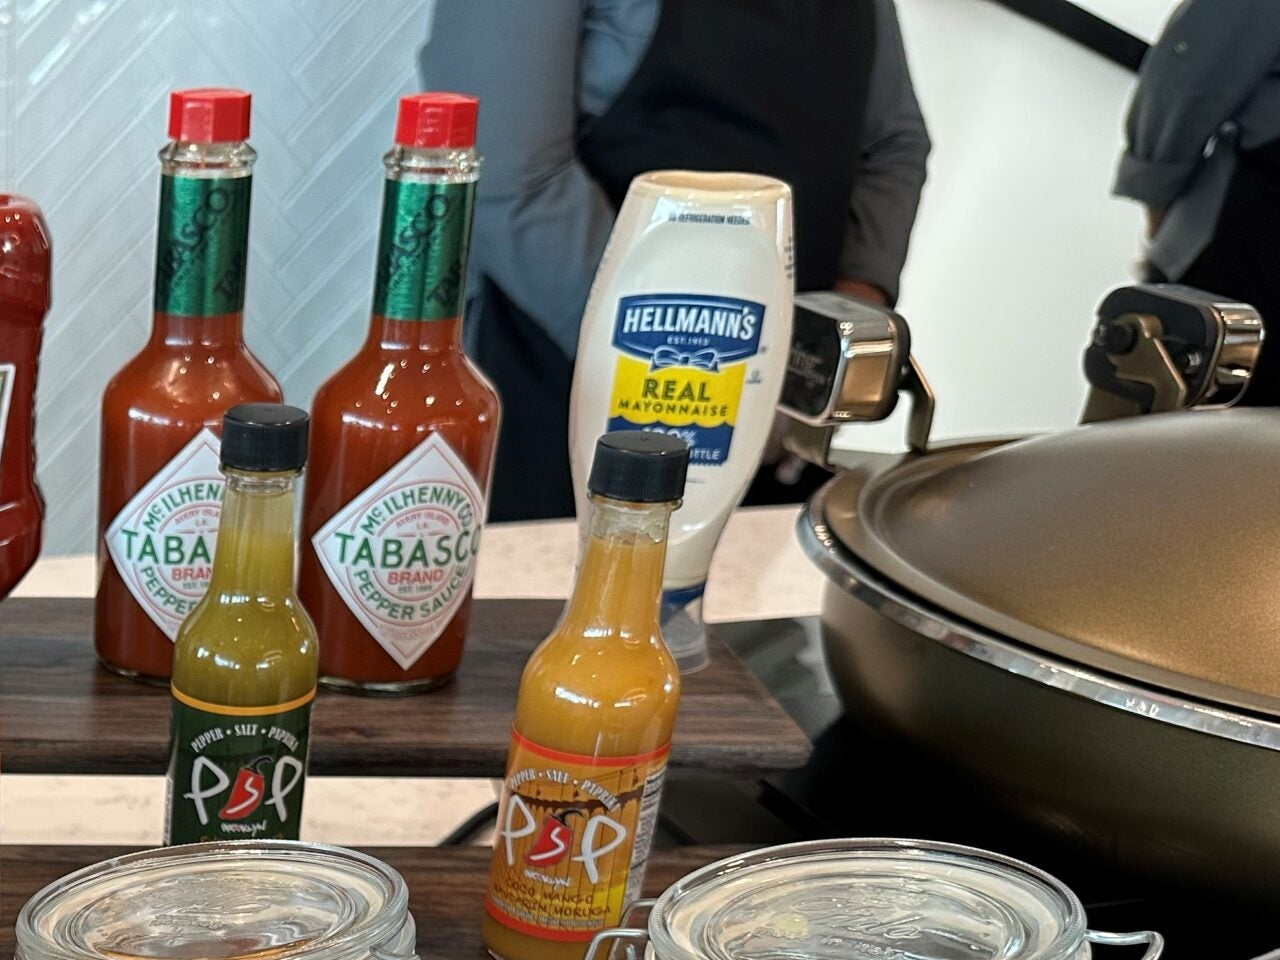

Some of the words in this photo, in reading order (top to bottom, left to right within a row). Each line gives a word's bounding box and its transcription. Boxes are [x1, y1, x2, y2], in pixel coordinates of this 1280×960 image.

[622, 305, 756, 340] HELLMANN'S
[642, 378, 712, 402] REAL
[618, 398, 728, 417] MAYONNAISE
[121, 529, 211, 565] TABA
[334, 524, 482, 569] TABASCO
[354, 568, 415, 621] PEPPER
[420, 565, 466, 619] SAUCE
[387, 569, 445, 585] BRAND
[191, 727, 224, 753] PEPPER
[234, 724, 258, 736] SALT
